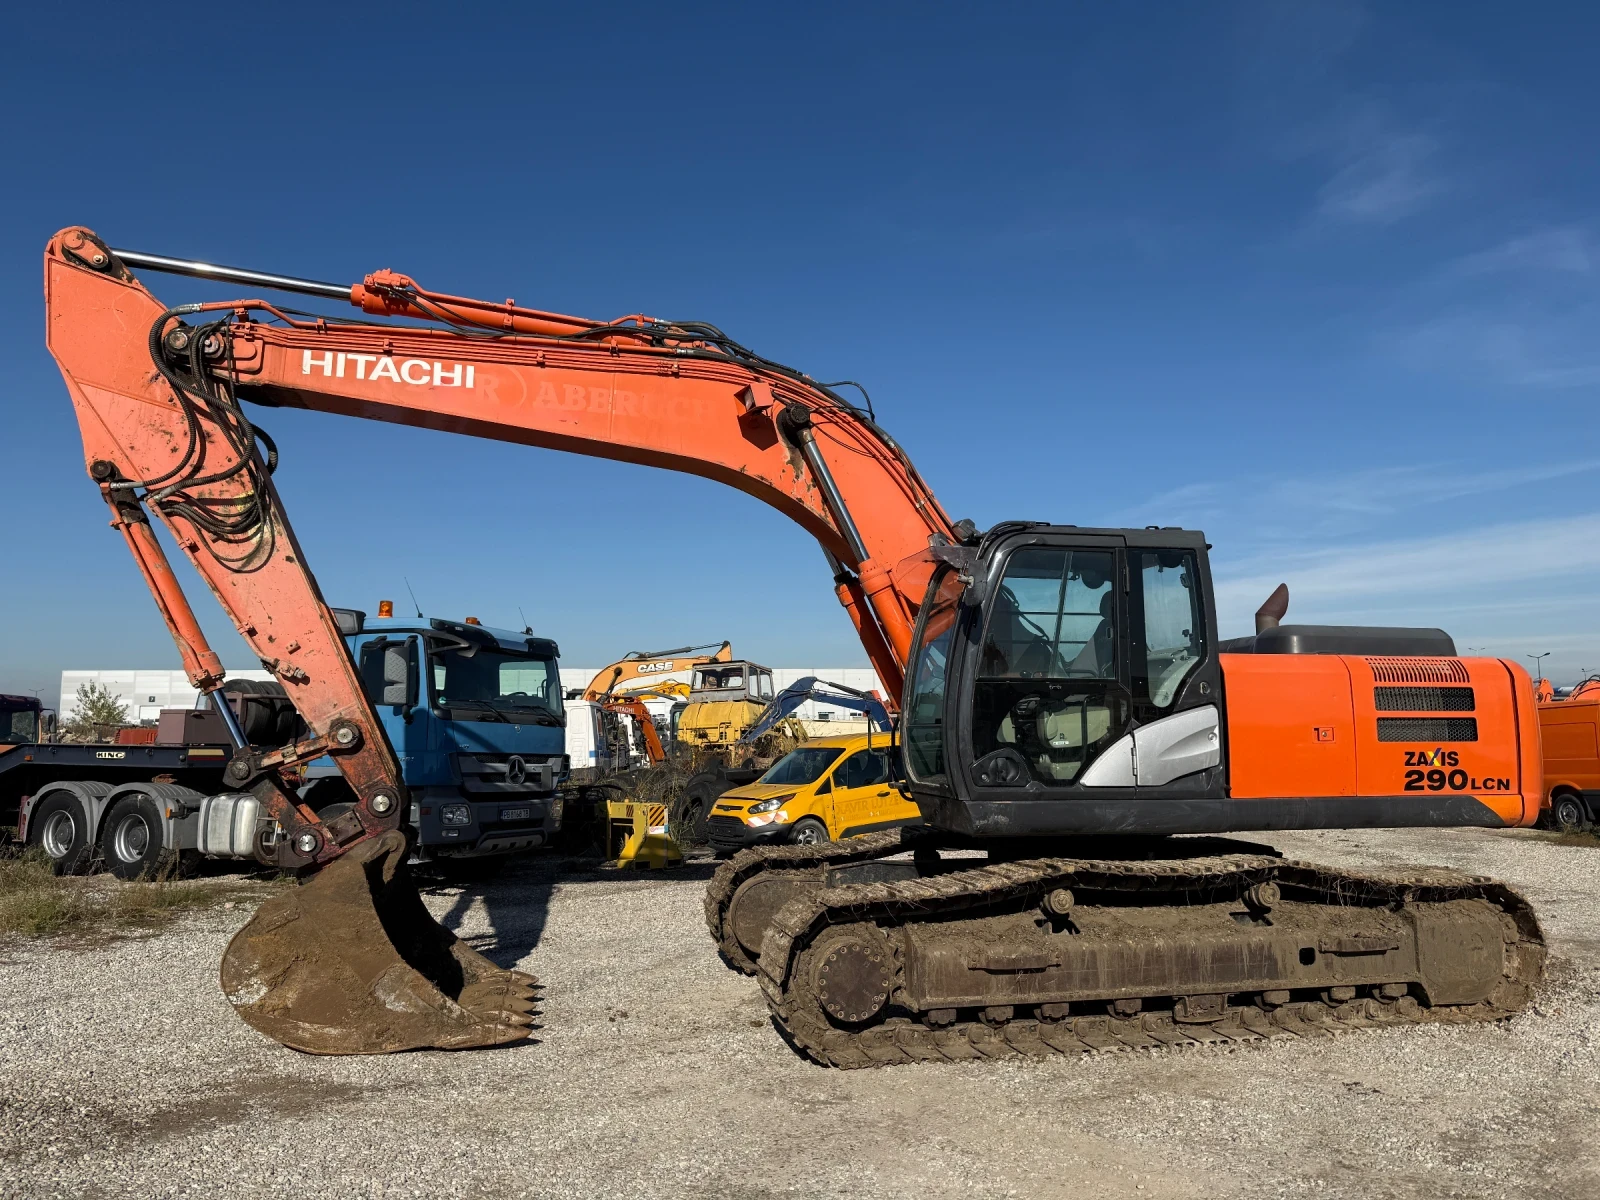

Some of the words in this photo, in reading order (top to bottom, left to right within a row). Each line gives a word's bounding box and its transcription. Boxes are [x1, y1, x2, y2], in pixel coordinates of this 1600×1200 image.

[302, 349, 475, 389] HITACHI
[637, 661, 673, 673] CASE
[613, 705, 635, 714] HITACHI
[1404, 747, 1459, 767] ZAXIS
[1404, 769, 1468, 791] 290
[1471, 777, 1510, 790] LCN
